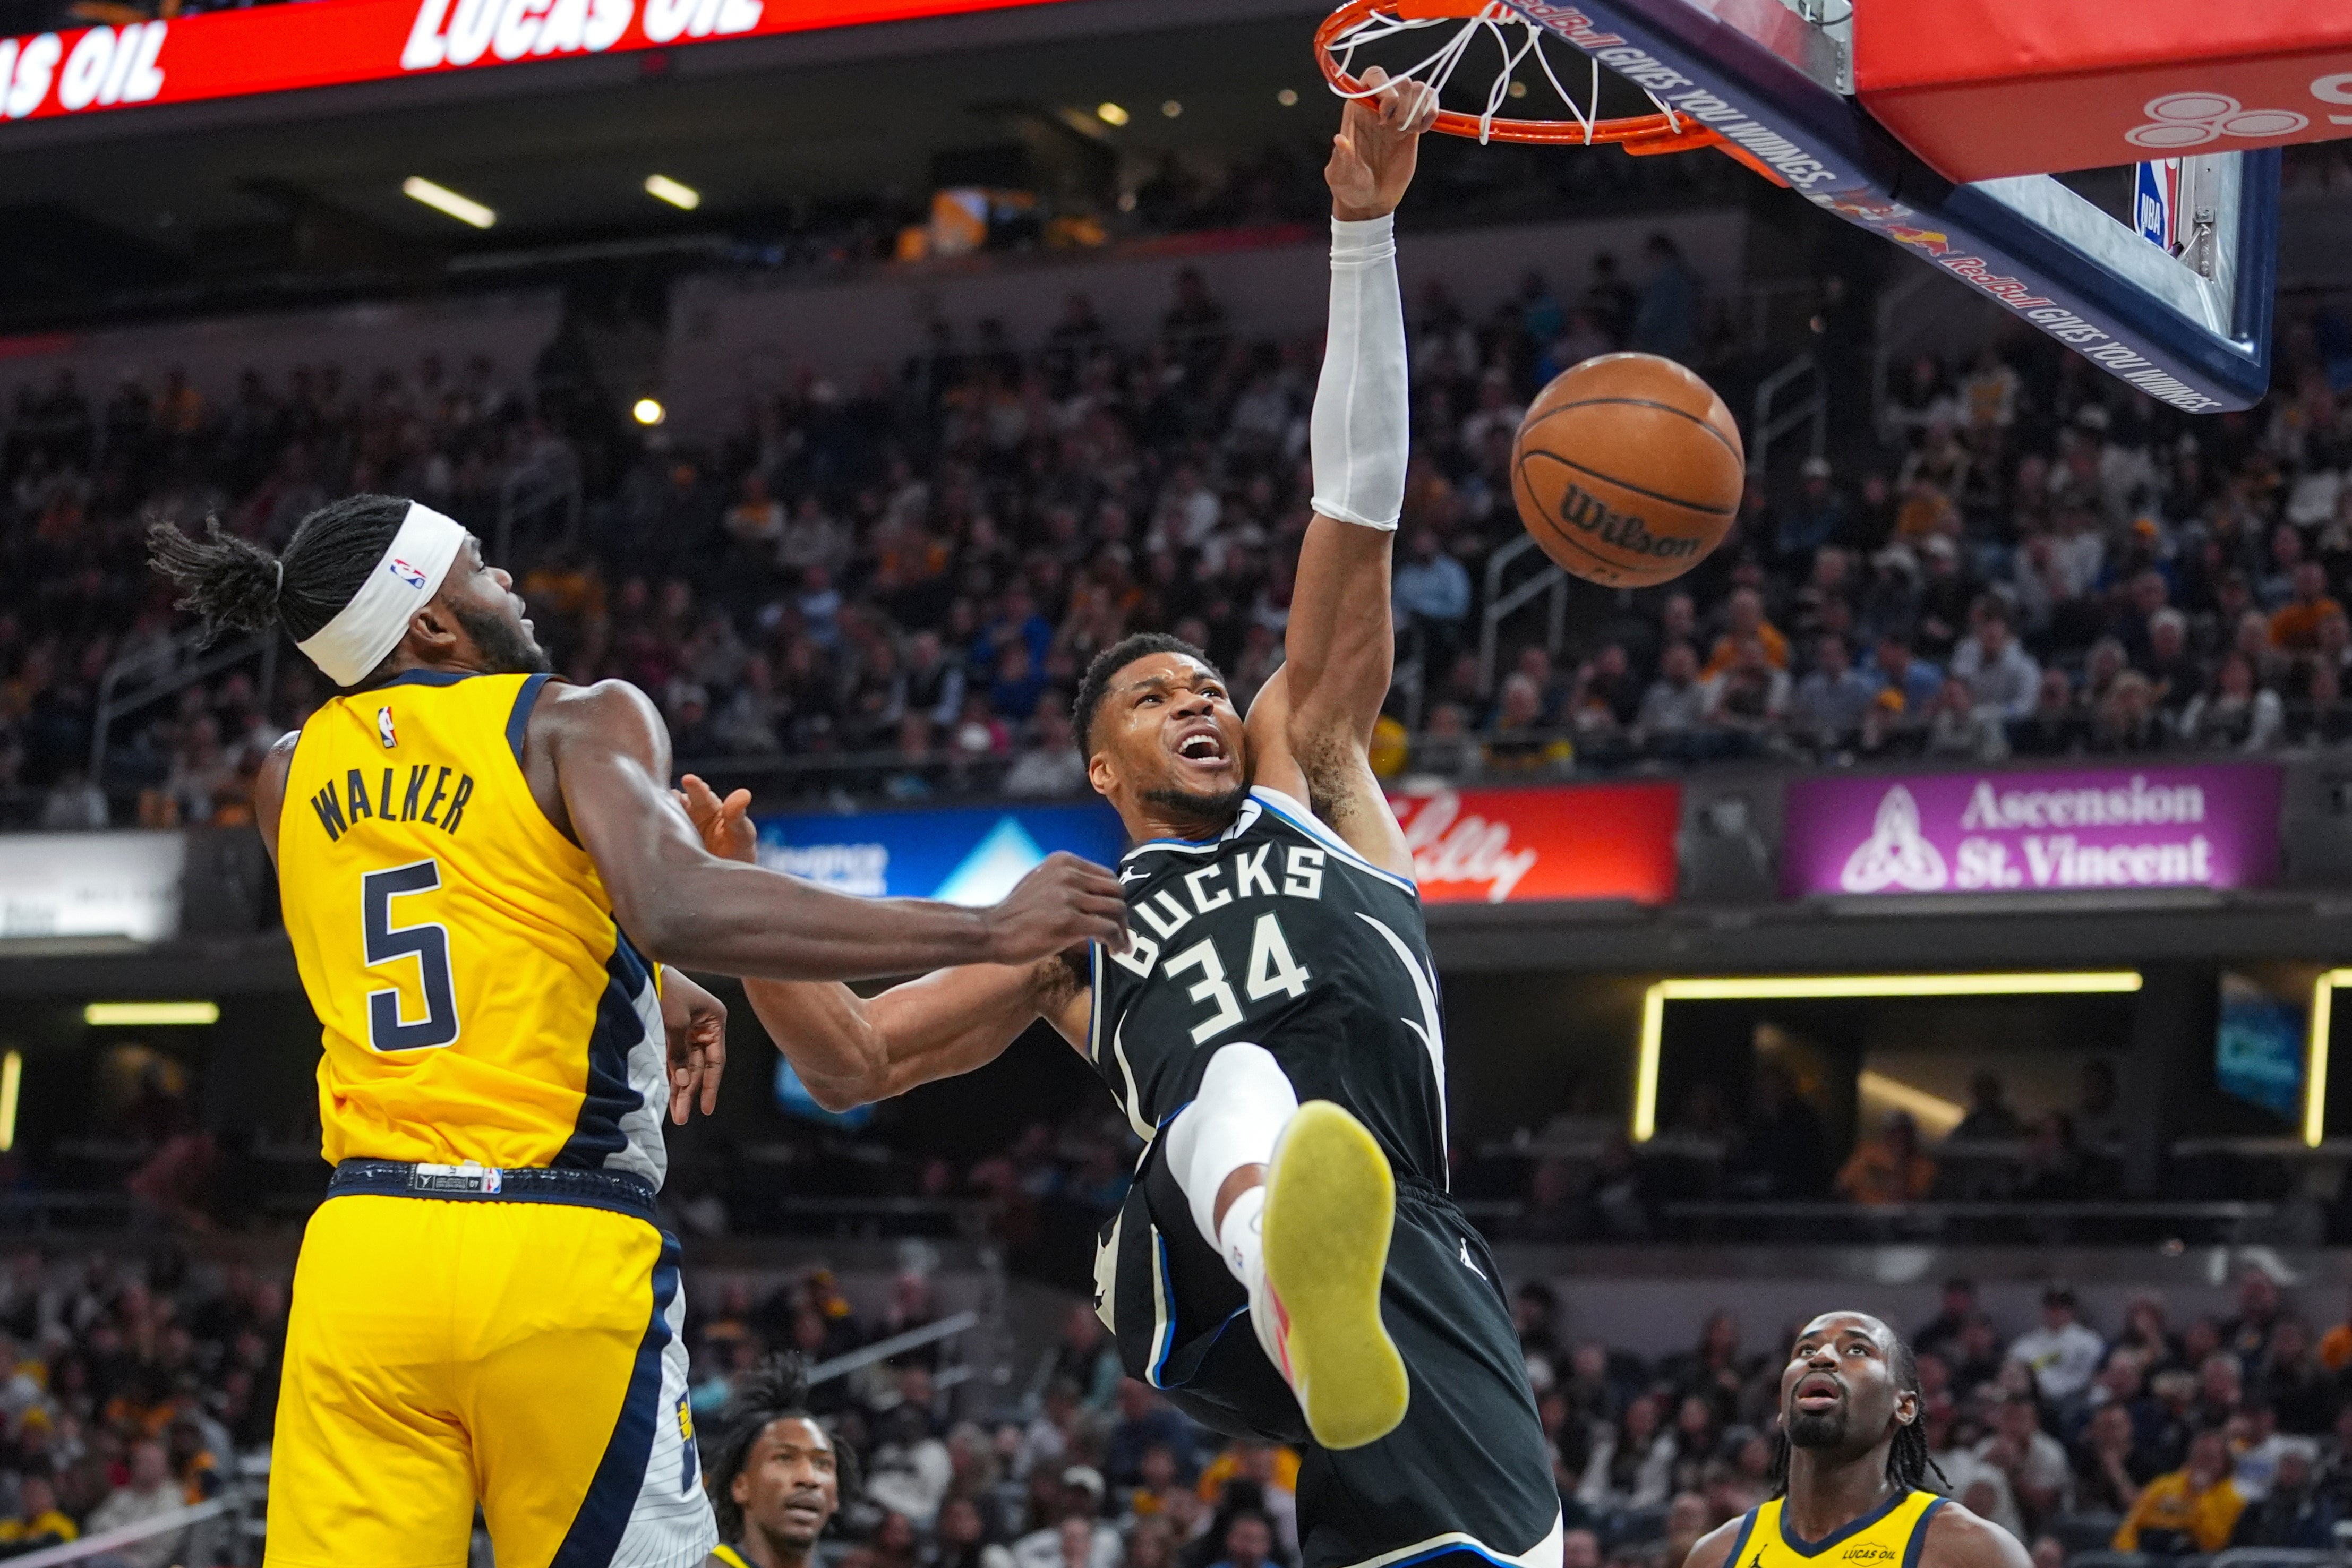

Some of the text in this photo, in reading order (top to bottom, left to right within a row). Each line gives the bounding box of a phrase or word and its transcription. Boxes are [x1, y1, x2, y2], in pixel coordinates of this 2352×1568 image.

[57, 19, 168, 112] OIL
[399, 0, 635, 70] LUCAS
[1507, 0, 1628, 49] edBull
[1596, 47, 1694, 90] GIVES
[1667, 88, 1749, 122] YOU
[2140, 192, 2161, 236] NBA
[2026, 308, 2110, 343] GIVES
[2082, 341, 2153, 369] YOU
[1560, 482, 1701, 558] Wilson
[310, 764, 475, 843] WALKER
[1960, 774, 2205, 829] Ascension
[1954, 834, 2209, 888] St. Vincent
[1110, 840, 1326, 979] BUCKS
[361, 858, 460, 1053] 5
[1160, 909, 1313, 1048] 34
[1842, 1549, 1896, 1560] LUCAS OIL
